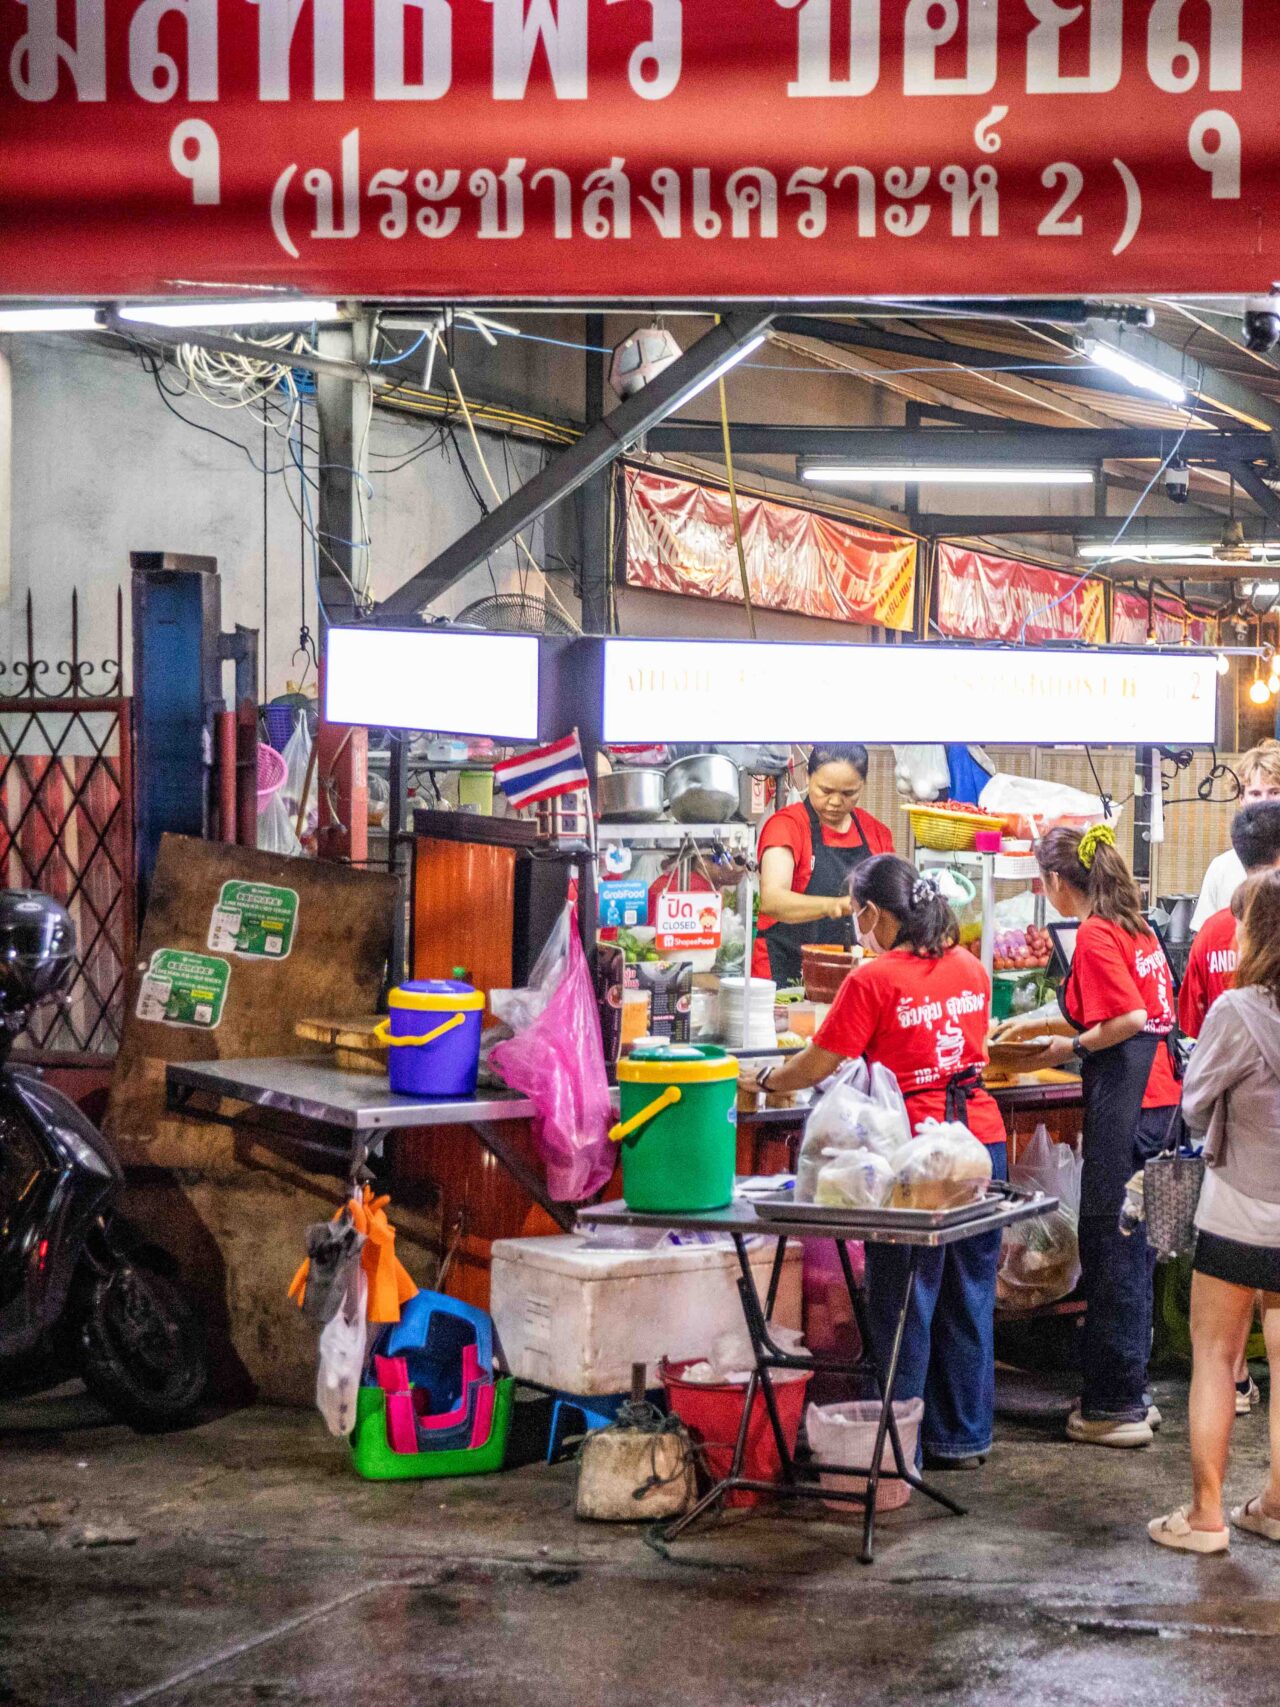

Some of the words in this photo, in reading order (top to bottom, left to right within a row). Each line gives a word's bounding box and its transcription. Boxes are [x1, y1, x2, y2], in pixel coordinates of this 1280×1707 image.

[603, 889, 645, 900] GrabFood
[667, 898, 693, 918] ปิด
[662, 921, 697, 931] CLOSED
[674, 937, 715, 948] ShopeeFood
